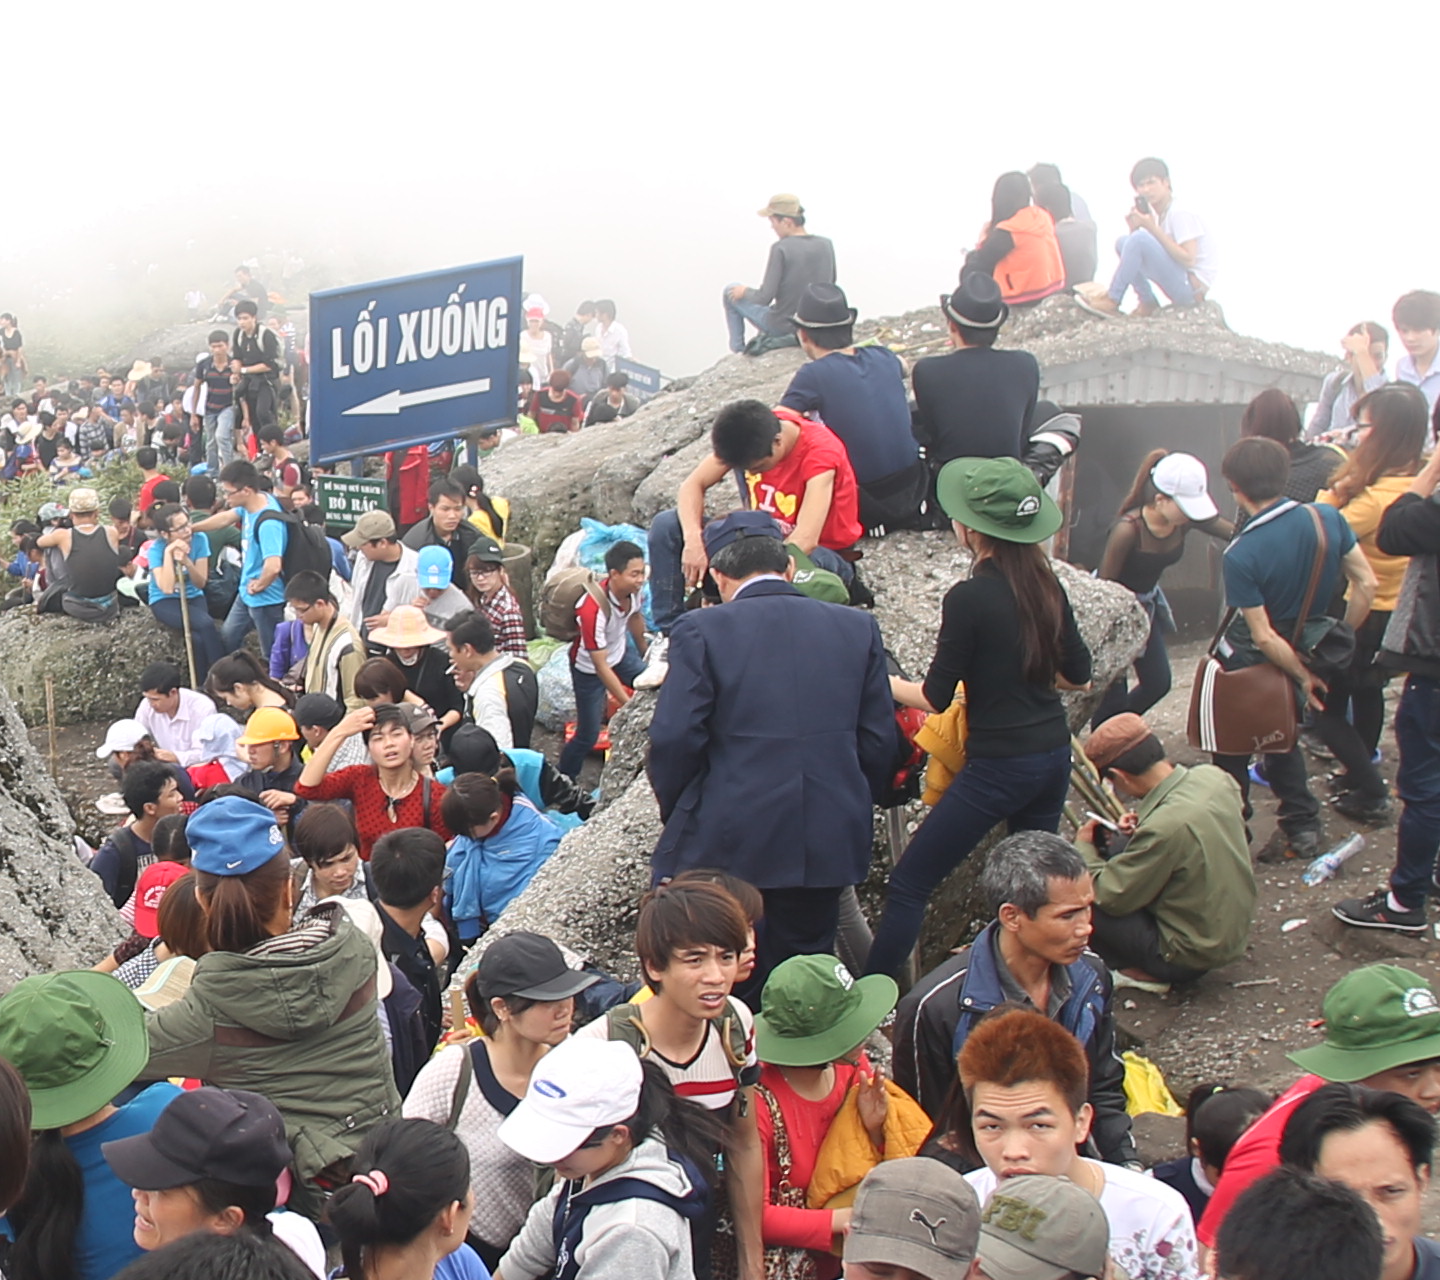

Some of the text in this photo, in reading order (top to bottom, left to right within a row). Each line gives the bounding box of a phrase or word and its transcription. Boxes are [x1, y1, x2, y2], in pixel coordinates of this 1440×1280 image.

[332, 283, 508, 379] LỐI XUỐNG
[328, 492, 378, 512] BỎ RÁC
[981, 1194, 1047, 1241] FBI
